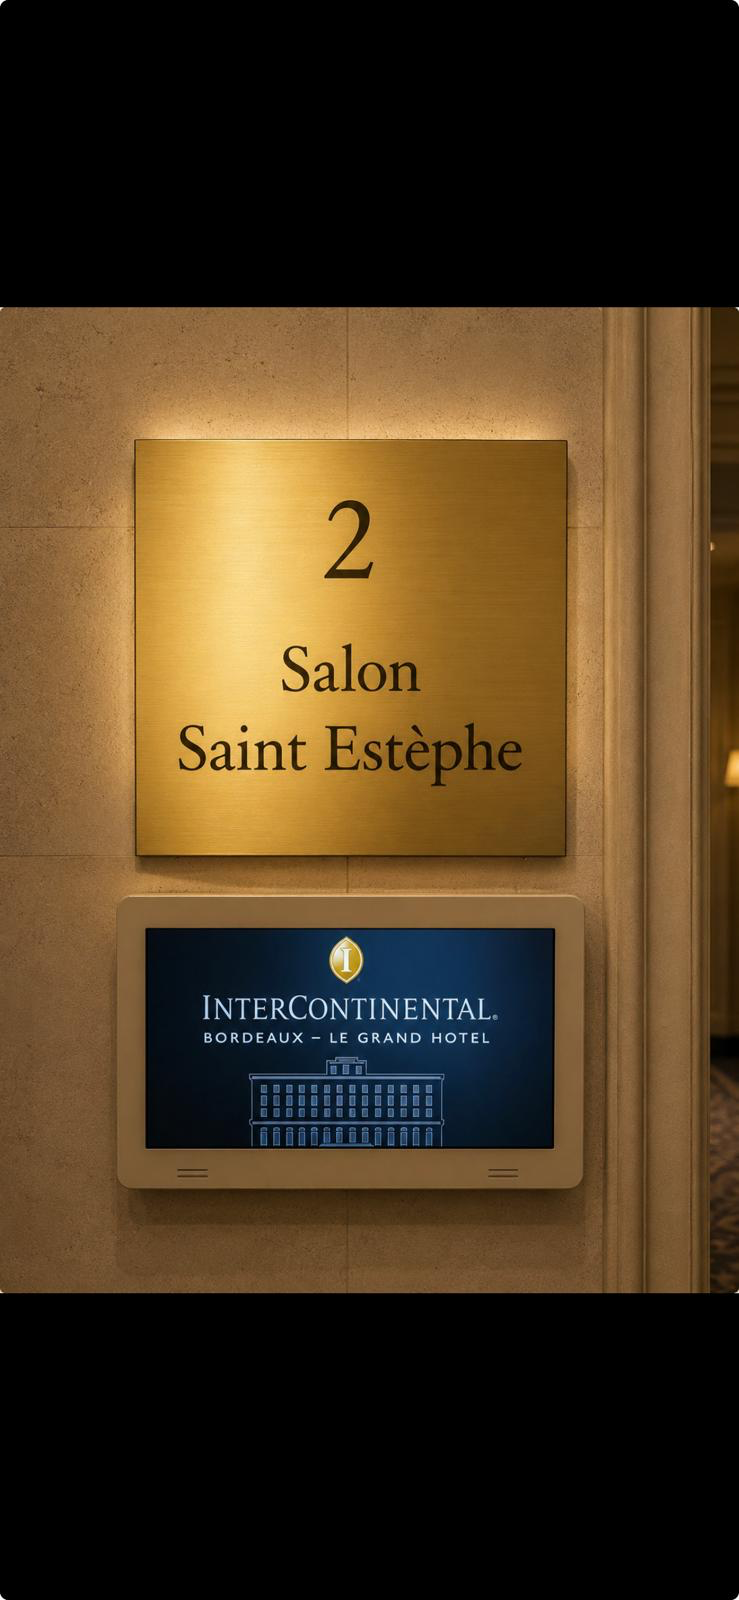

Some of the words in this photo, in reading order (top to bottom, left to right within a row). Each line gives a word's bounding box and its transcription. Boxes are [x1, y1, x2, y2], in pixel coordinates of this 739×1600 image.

[323, 499, 374, 580] 2
[281, 643, 421, 693] Salon
[178, 724, 308, 772] Saint
[324, 722, 522, 787] Estèphe
[203, 1031, 304, 1044] BORDEAUX
[329, 1031, 349, 1044] LE
[357, 1031, 422, 1044] GRAND
[431, 1031, 490, 1044] HOTEL
